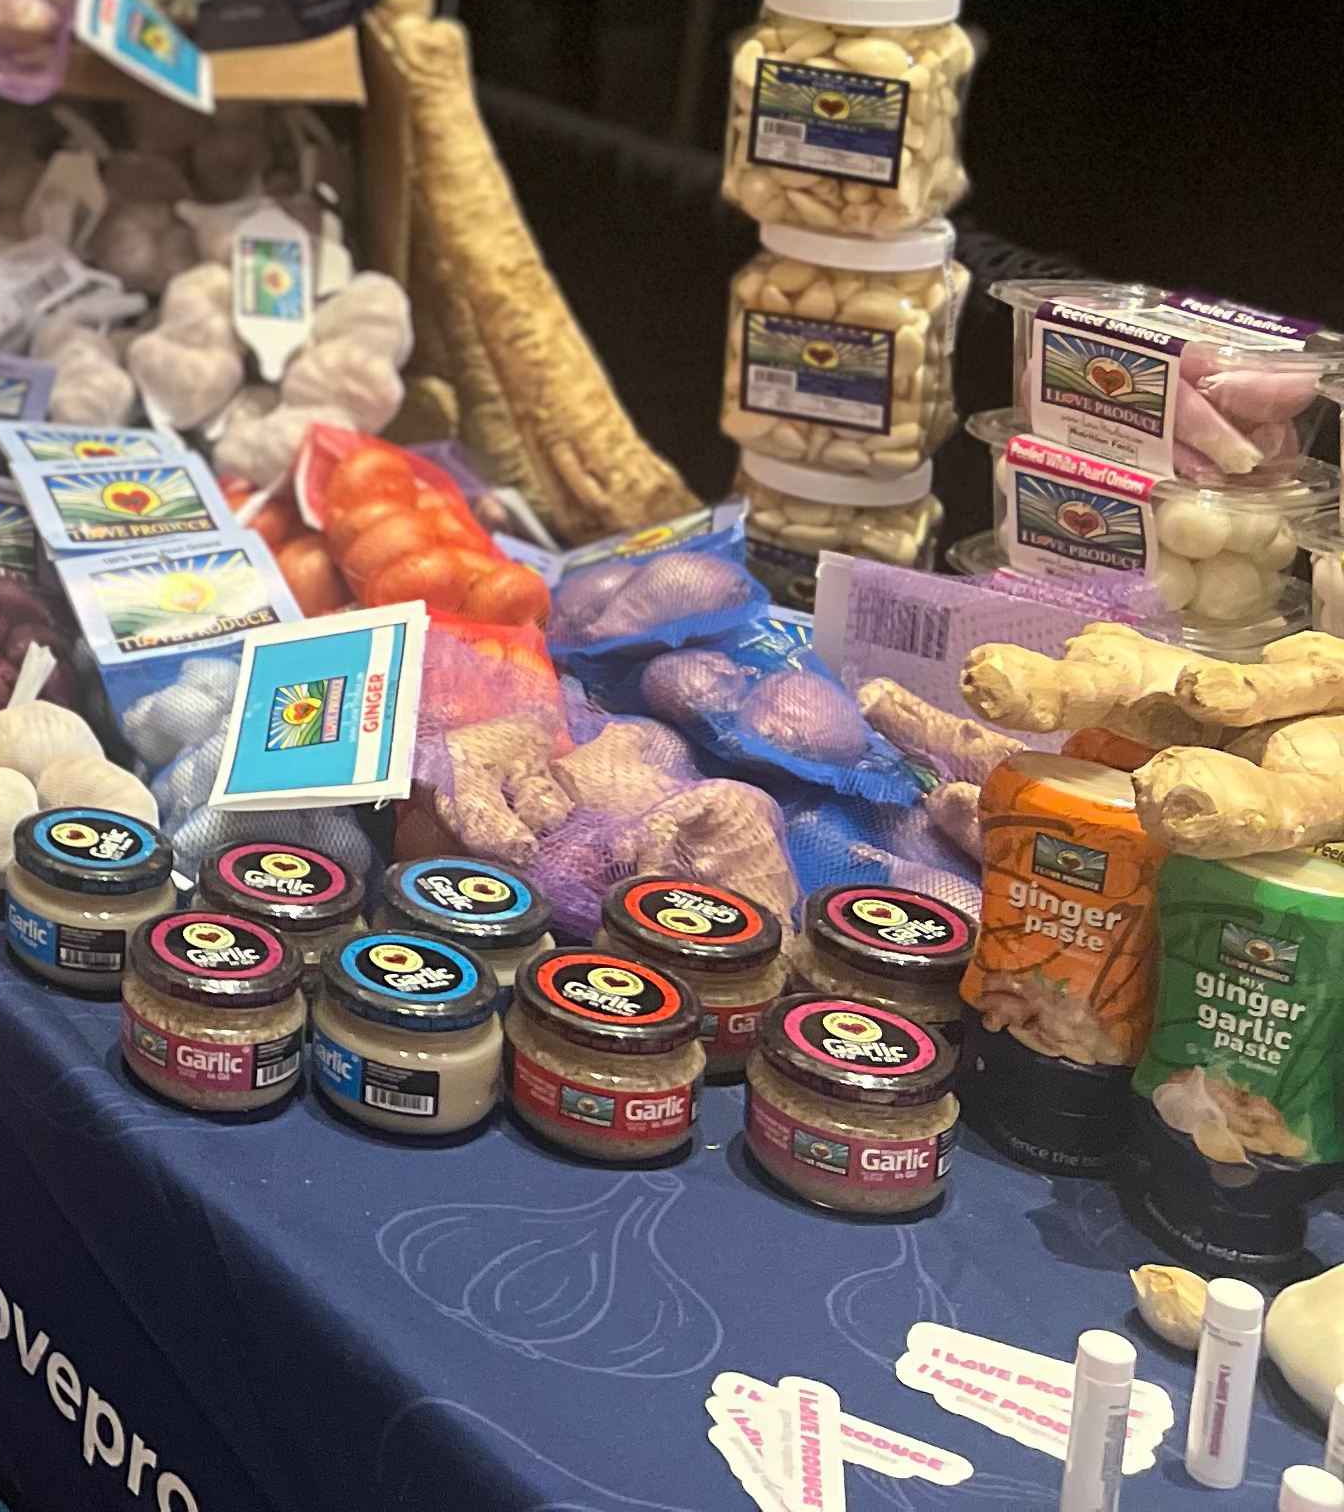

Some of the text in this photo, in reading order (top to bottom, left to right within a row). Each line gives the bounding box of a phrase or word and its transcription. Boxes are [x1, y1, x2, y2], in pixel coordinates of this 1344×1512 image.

[1094, 401, 1160, 433] PRODUCE
[1045, 451, 1077, 474] White
[1077, 461, 1108, 484] Pearl
[1106, 471, 1145, 495] Onions
[130, 518, 211, 537] PRODUCE
[1069, 546, 1142, 571] PRODUCE
[185, 610, 273, 641] PRODUCE
[362, 673, 385, 734] GINGER
[244, 870, 315, 895] Garlic
[664, 891, 737, 924] Garlic
[1008, 880, 1122, 930] ginger
[9, 903, 48, 946] Garlic
[1025, 915, 1104, 952] paste
[187, 946, 260, 964] Garlic
[384, 966, 455, 987] Garlic
[564, 981, 641, 1014] Garlic
[1195, 971, 1306, 1021] ginger
[1197, 1004, 1292, 1050] garlic
[176, 1045, 243, 1074] Garlic
[822, 1038, 908, 1059] Garlic
[1214, 1031, 1281, 1065] paste
[625, 1095, 685, 1121] Garlic
[861, 1148, 930, 1172] Garlic
[840, 1423, 945, 1472] RODUCE
[800, 1434, 823, 1508] PRODUCE
